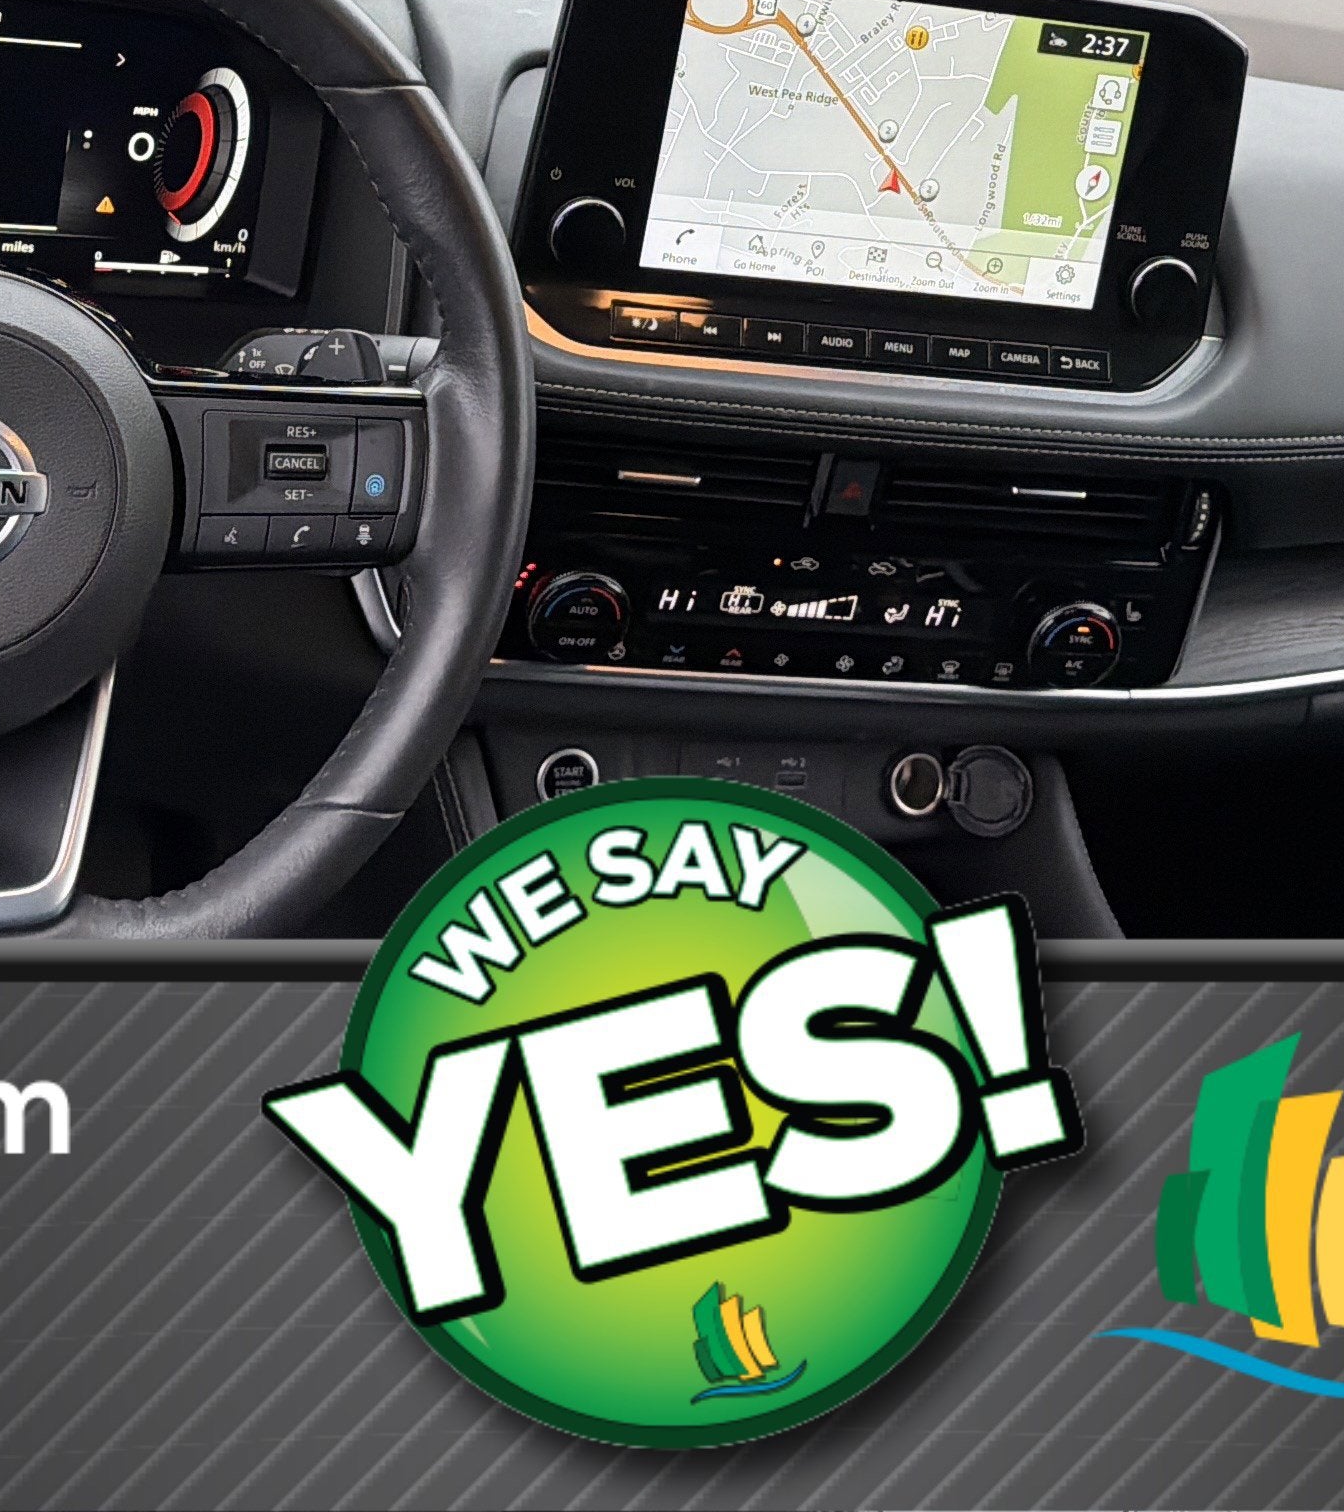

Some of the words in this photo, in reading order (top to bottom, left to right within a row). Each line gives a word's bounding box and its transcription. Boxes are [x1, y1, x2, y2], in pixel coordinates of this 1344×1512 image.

[760, 1, 773, 10] 60
[860, 14, 895, 45] Braley
[1081, 33, 1130, 57] 2:37
[748, 84, 780, 99] West
[782, 88, 802, 101] Pea
[805, 91, 839, 106] Ridge
[133, 106, 159, 117] MPH
[614, 178, 636, 188] VOL
[975, 164, 1001, 232] Longwood
[993, 144, 1006, 161] Rd
[773, 183, 808, 219] Forest
[1119, 225, 1144, 235] TUNE
[1116, 232, 1147, 243] SCROLL
[1185, 233, 1209, 242] PUSH
[1, 240, 35, 254] miles
[214, 240, 246, 254] km/h
[1180, 240, 1210, 250] SOUND
[662, 252, 698, 266] Phone
[733, 260, 747, 270] Go
[749, 261, 777, 272] Home
[805, 266, 825, 277] POI
[849, 270, 900, 284] Destination
[911, 276, 936, 287] Zoom
[940, 278, 955, 289] Out
[973, 282, 998, 293] Zoom
[1046, 289, 1081, 303] Settings
[821, 335, 854, 350] AUDIO
[884, 341, 914, 355] MENU
[948, 347, 972, 360] MAP
[1001, 351, 1041, 365] CAMERA
[249, 360, 266, 369] OFF
[1074, 357, 1101, 371] BACK
[287, 426, 317, 438] RES+
[274, 457, 320, 470] CANCEL
[734, 585, 757, 595] SYNC
[658, 589, 697, 612] Hi
[938, 598, 960, 608] SYNC
[569, 605, 599, 616] AUTO
[924, 605, 962, 627] Hi
[1069, 635, 1093, 645] SYNC
[553, 766, 584, 778] START
